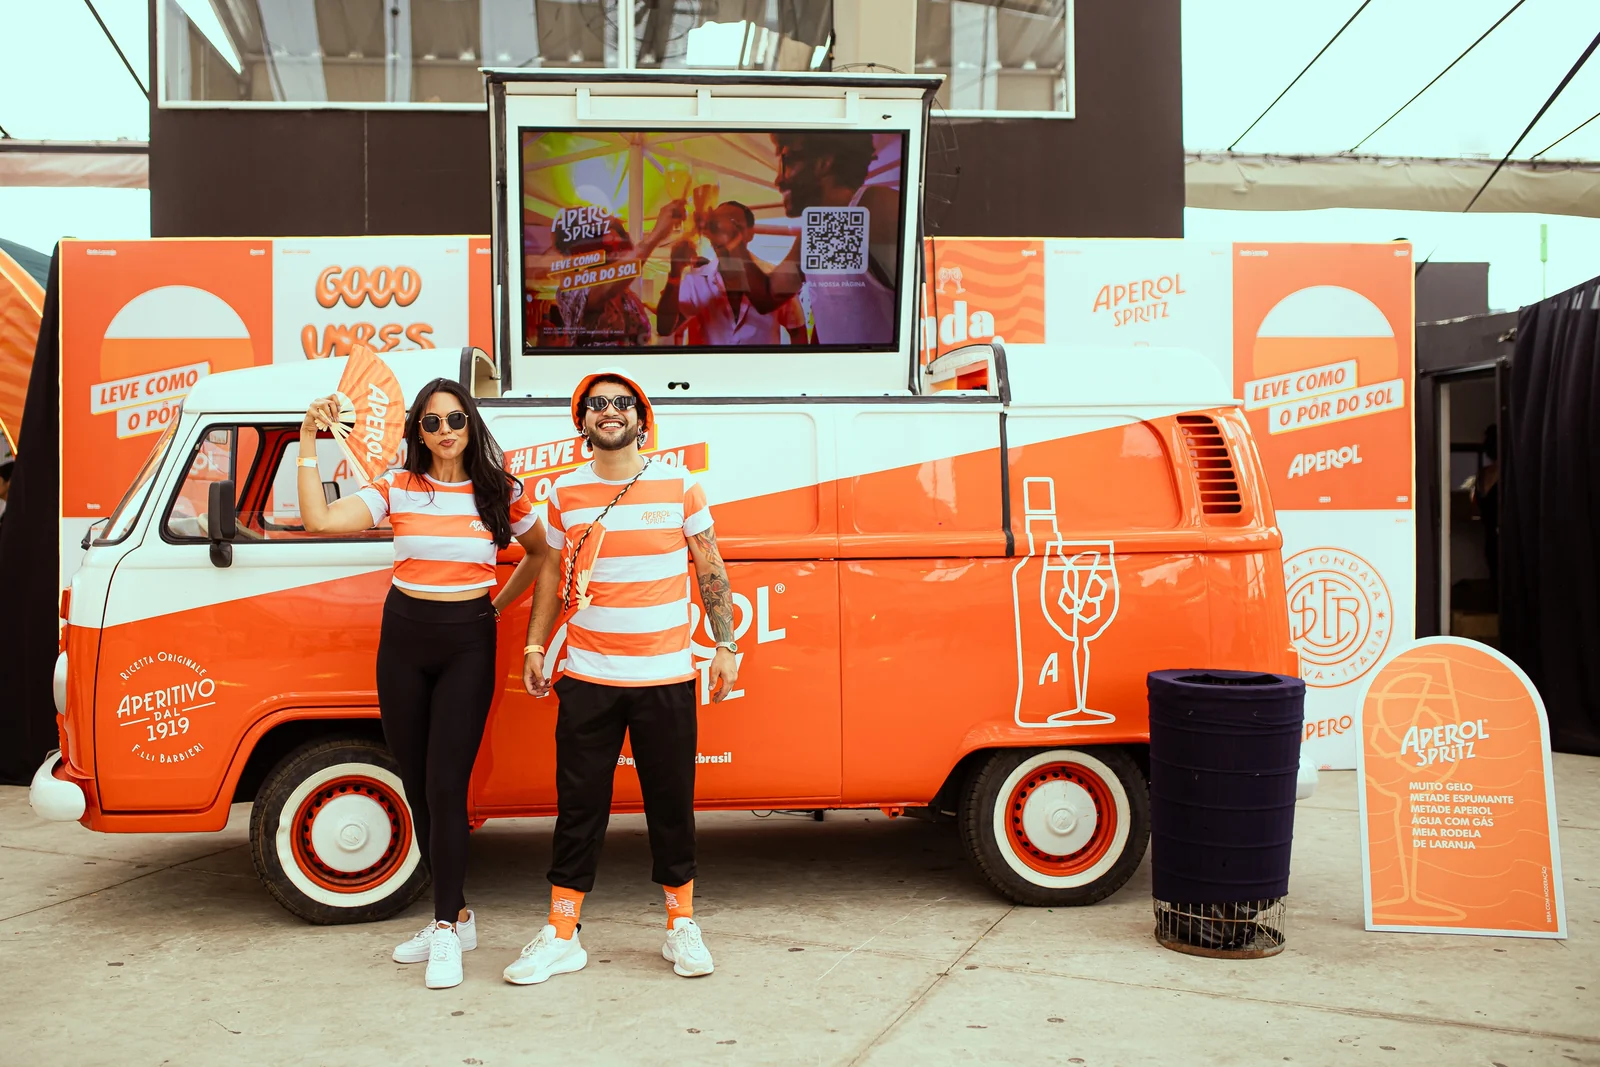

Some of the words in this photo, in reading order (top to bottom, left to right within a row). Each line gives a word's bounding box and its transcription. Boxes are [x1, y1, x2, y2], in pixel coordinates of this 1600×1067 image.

[551, 205, 622, 232] APEROL
[551, 258, 571, 271] LEVE
[573, 253, 600, 267] COMO
[563, 276, 571, 288] O
[574, 269, 597, 286] PÔR
[600, 266, 615, 280] DO
[618, 263, 637, 277] SOL
[315, 265, 422, 308] GOOD
[1092, 272, 1186, 313] APEROL
[1113, 301, 1169, 327] SPRITZ
[100, 381, 139, 405] LEVE
[145, 370, 198, 395] COMO
[1253, 379, 1290, 402] LEVE
[1296, 367, 1345, 392] COMO
[1279, 409, 1291, 426] O
[1297, 398, 1331, 423] PÔR
[1337, 395, 1359, 414] DO
[1365, 388, 1392, 409] SOL
[128, 413, 140, 431] O
[363, 383, 389, 462] APEROL
[510, 438, 576, 474] #LEVE
[1287, 445, 1362, 479] APEROL
[1308, 555, 1381, 601] FONDATA
[119, 655, 154, 680] RICETTA
[157, 651, 207, 677] ORIGINALE
[1341, 630, 1384, 676] ITALIA
[116, 678, 215, 719] APERITIVO
[153, 707, 180, 721] DAL
[146, 716, 190, 742] 1919
[1300, 715, 1352, 742] PERO
[1400, 719, 1489, 755] APEROL
[159, 742, 205, 763] BARBIERI
[1409, 781, 1443, 791] MUITO
[1445, 782, 1473, 792] GELO
[1410, 793, 1450, 803] METADE
[1453, 794, 1514, 804] ESPUMANTE
[1410, 805, 1451, 814] METADE
[1453, 806, 1492, 815] APEROL
[1411, 813, 1442, 825] ÁGUA
[1444, 817, 1470, 826] COM
[1472, 815, 1494, 827] GÁS
[1412, 827, 1438, 837] MEIA
[1440, 828, 1481, 838] RODELA
[1413, 839, 1426, 848] DE
[1429, 839, 1476, 849] LARANJA
